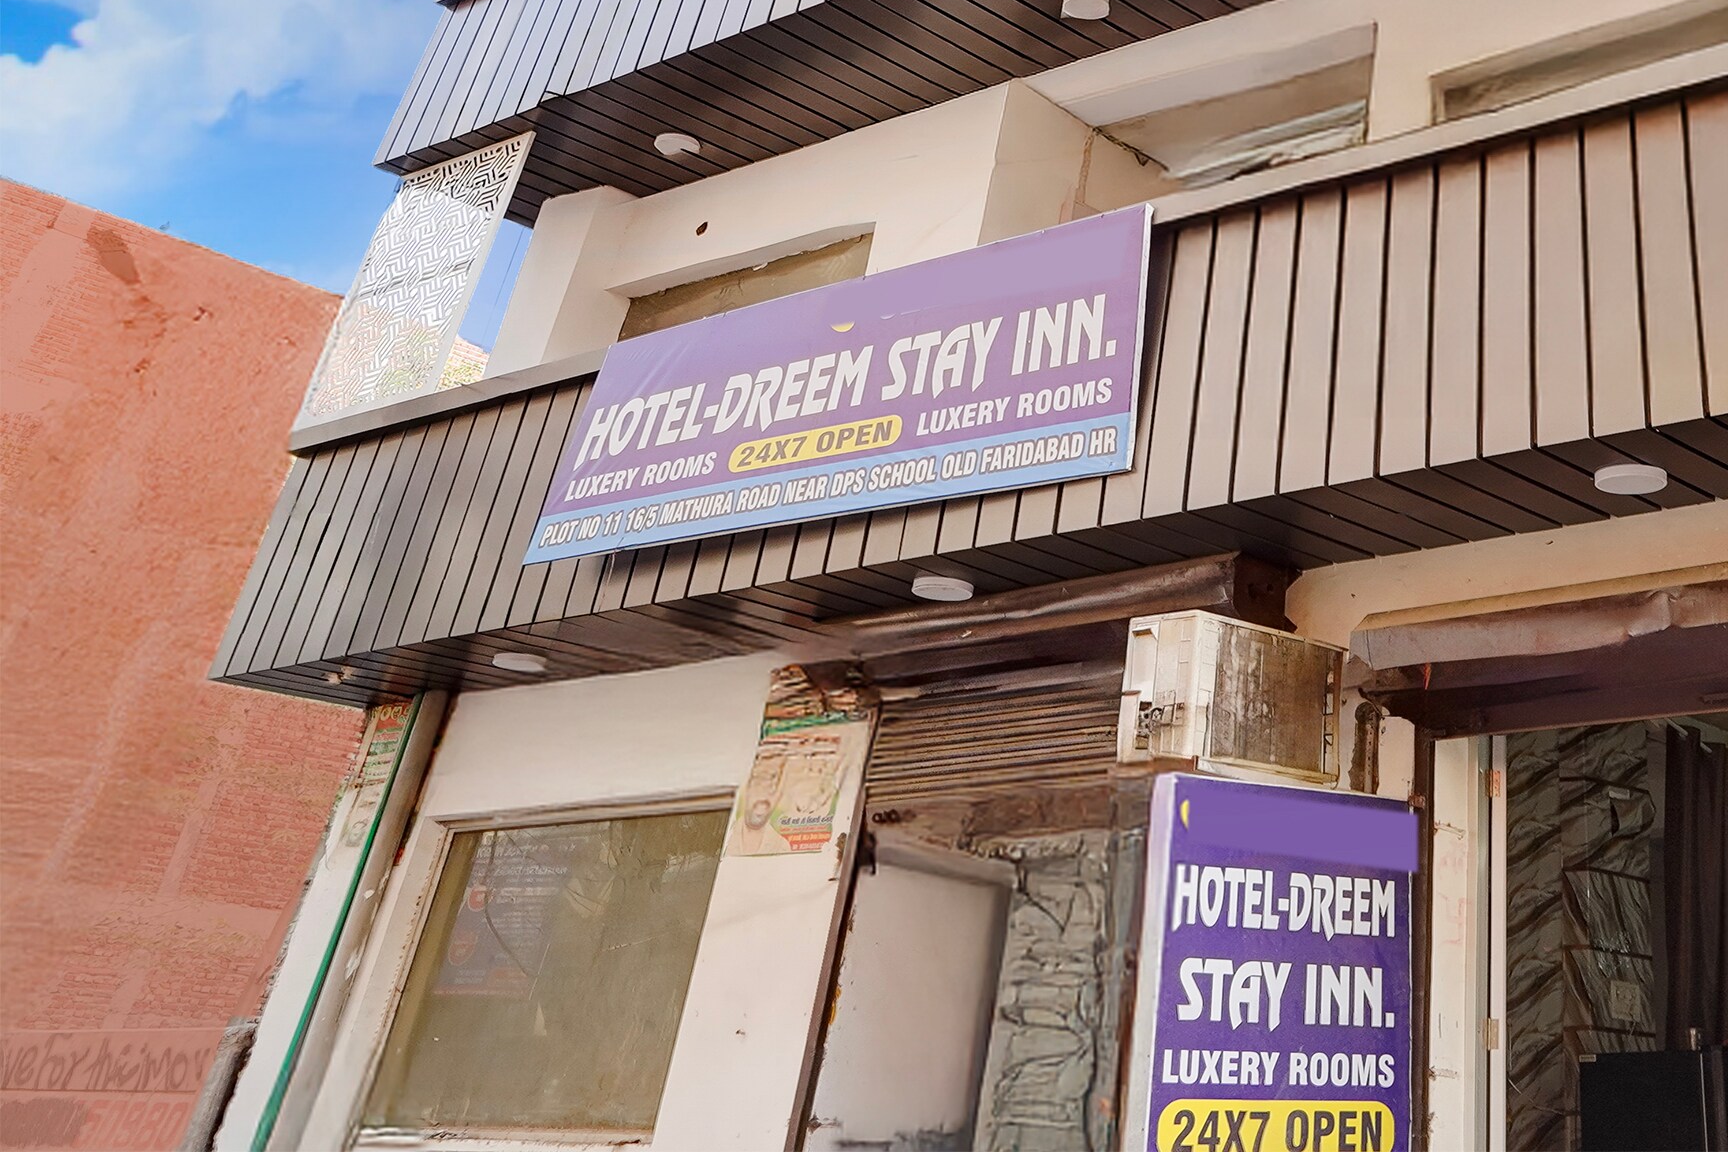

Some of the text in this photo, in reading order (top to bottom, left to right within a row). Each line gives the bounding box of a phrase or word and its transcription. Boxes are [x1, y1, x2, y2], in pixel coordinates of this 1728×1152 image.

[573, 293, 1118, 471] HOTEL-DREEM STAY INN.
[915, 378, 1114, 438] LUXERY ROOMS
[735, 419, 894, 469] 24X7 OPEN
[539, 426, 1118, 548] PLOT NO 11 16/5 MATHURA ROAD NEAR DPS SCHOOL OLD FARIDABAD HR
[565, 451, 716, 503] LUXERY ROOMS
[1172, 864, 1396, 941] HOTEL-DREEM
[1177, 958, 1395, 1032] STAY INN.
[1162, 1049, 1396, 1088] LUXERY ROOMS
[1172, 1109, 1383, 1152] 24X7 OPEN
